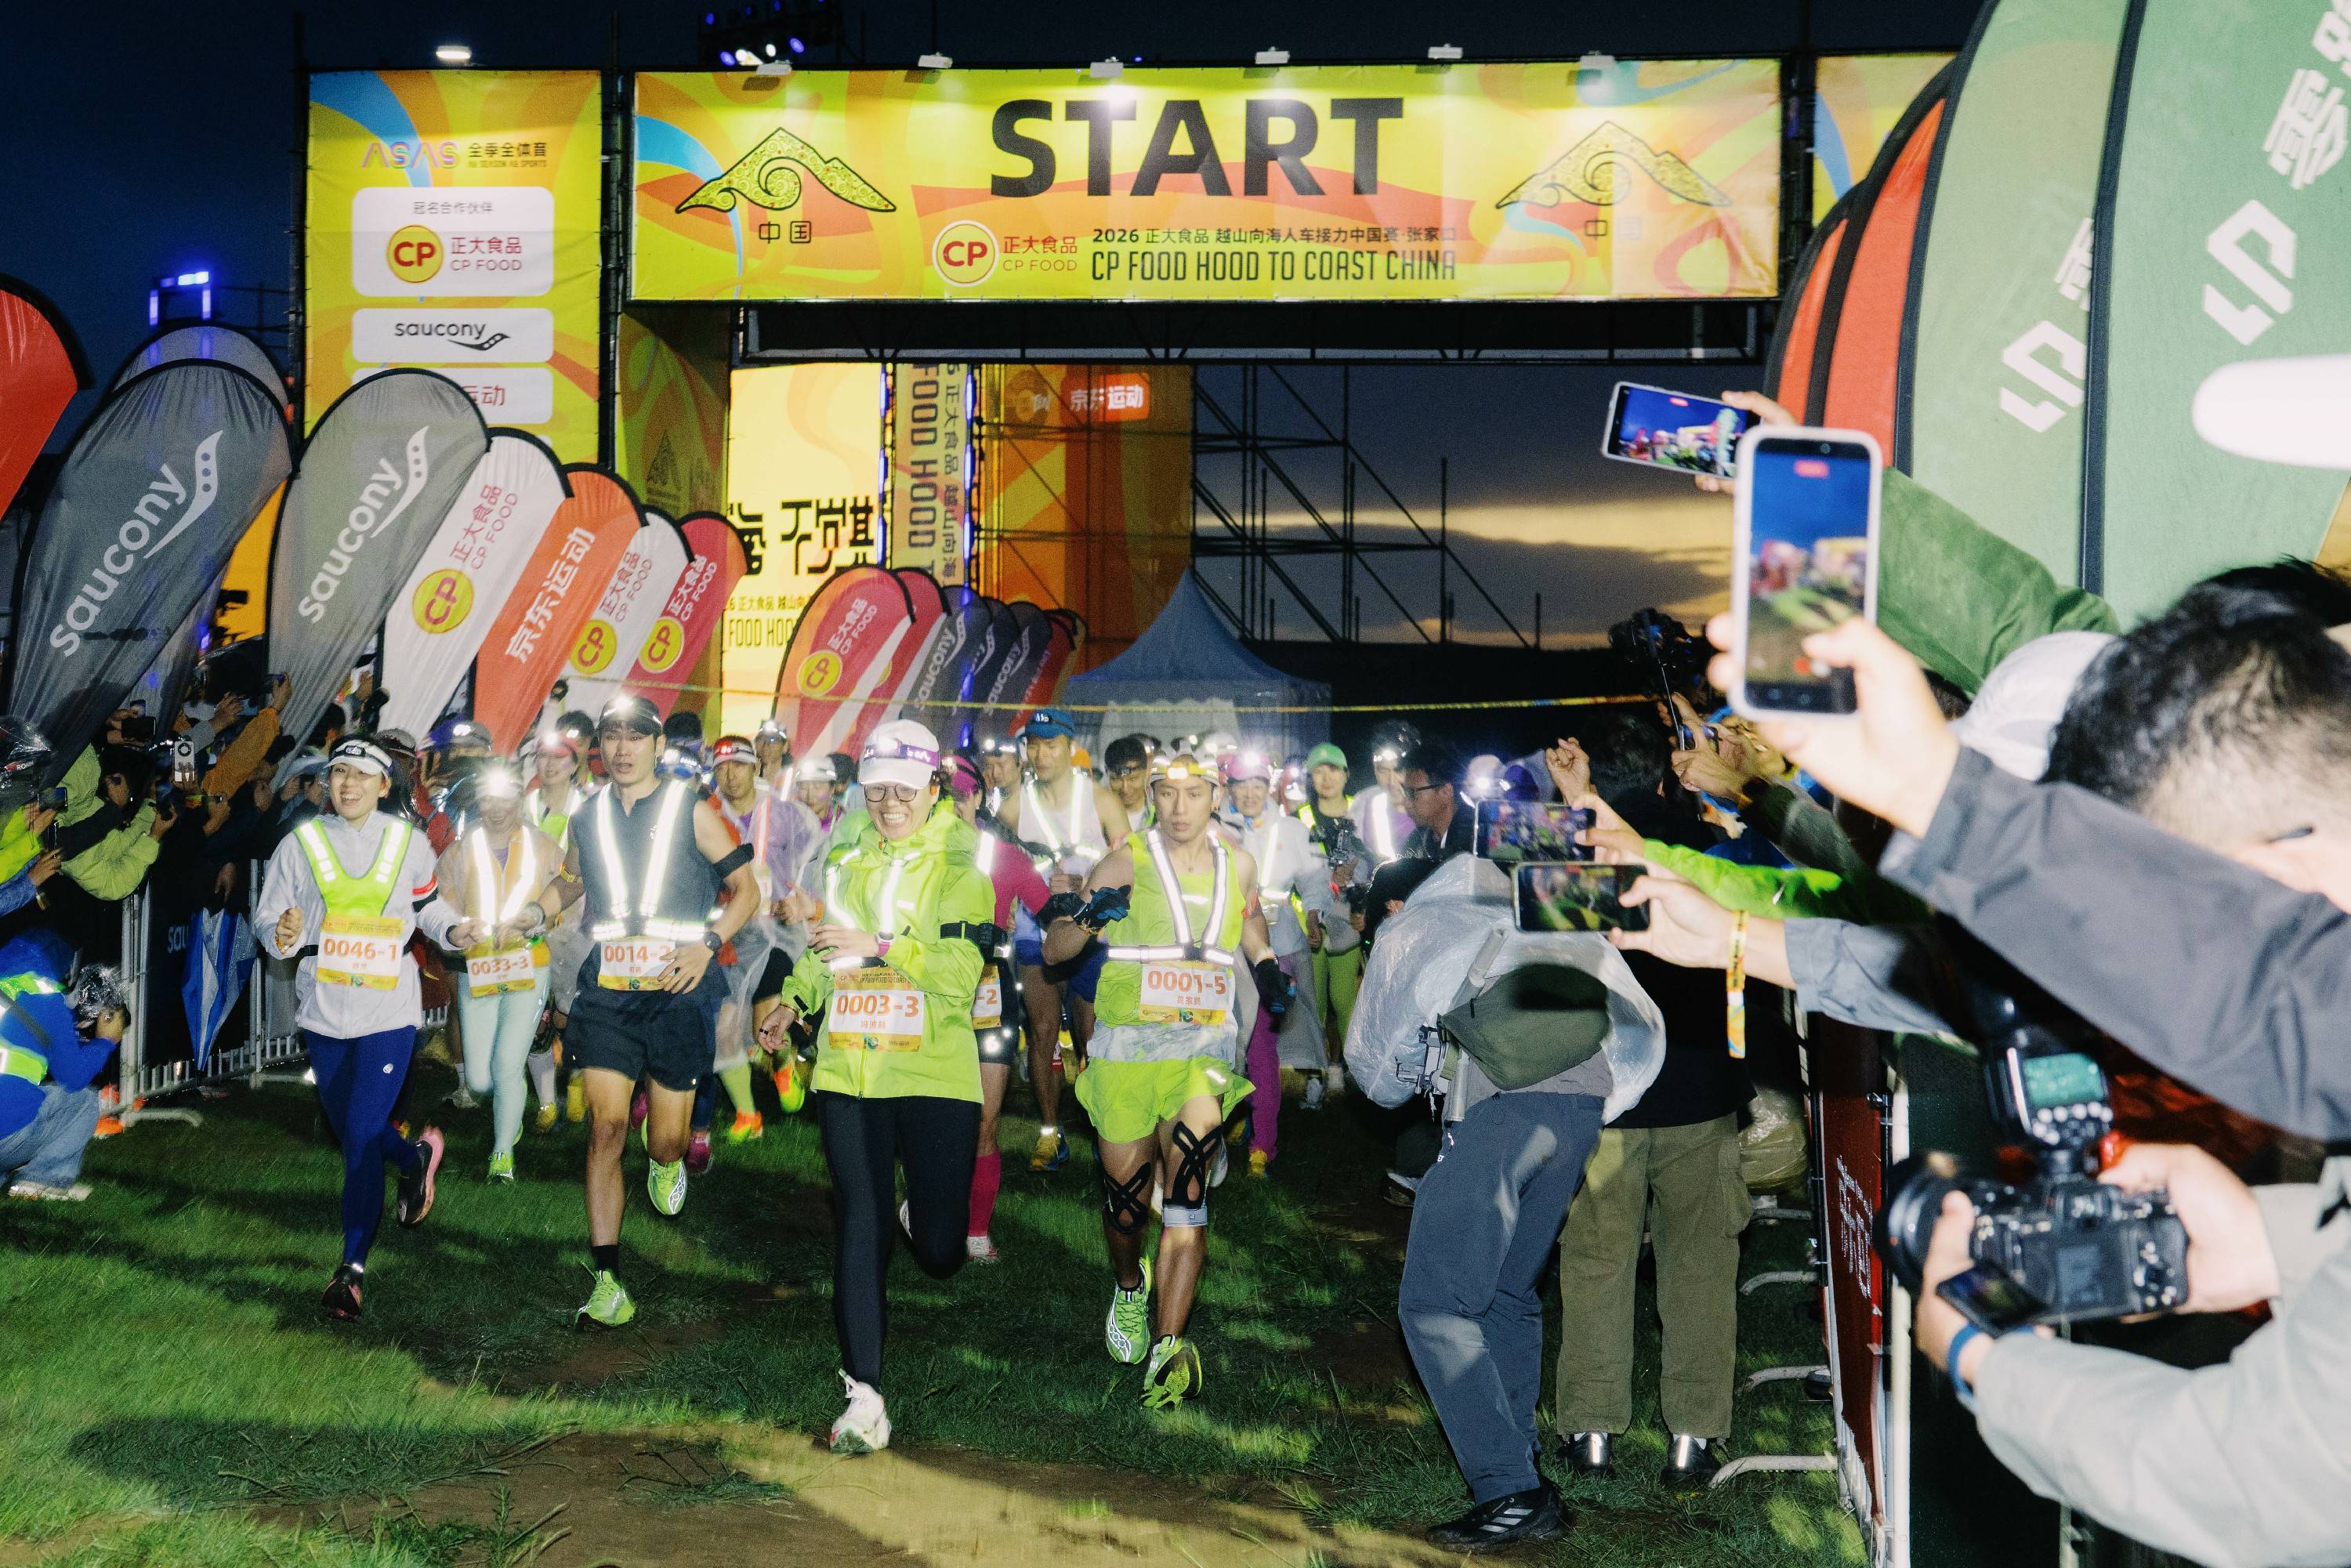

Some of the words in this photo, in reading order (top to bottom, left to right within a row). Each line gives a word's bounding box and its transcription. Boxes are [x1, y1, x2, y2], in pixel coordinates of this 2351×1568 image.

[469, 143, 547, 158] 全季全体育
[991, 97, 1404, 197] START
[451, 237, 522, 254] 正大食品
[759, 220, 812, 244] 中国
[1003, 235, 1078, 254] 正大食品
[1092, 228, 1139, 243] 2026
[1146, 228, 1209, 244] 正大食品
[1215, 227, 1399, 244] 越山向海人车接力中国赛
[1407, 227, 1456, 243] 张家口
[393, 241, 437, 267] CP
[451, 259, 470, 271] CP
[476, 259, 522, 271] FOOD
[943, 241, 988, 267] CP
[1002, 259, 1023, 271] CP
[1030, 259, 1078, 271] FOOD
[1092, 251, 1119, 281] CP
[1128, 251, 1187, 281] FOOD
[1196, 251, 1259, 281] HOOD
[1268, 251, 1295, 281] TO
[1304, 251, 1378, 281] COAST
[1386, 250, 1456, 281] CHINA
[395, 323, 487, 340] saucony
[907, 459, 938, 549] HOOD
[450, 483, 502, 563] 正大食品
[470, 546, 487, 570] CP
[485, 493, 518, 543] FOOD
[298, 458, 404, 624] saucony
[50, 464, 187, 657] saucony
[505, 527, 596, 664] 京东运动
[600, 551, 640, 616] 正大食品
[615, 603, 628, 622] CP
[627, 559, 653, 601] FOOD
[668, 554, 707, 616] 正大食品
[680, 602, 694, 621] CP
[691, 562, 718, 602] FOOD
[424, 576, 458, 626] CP
[578, 627, 604, 667] CP
[648, 625, 671, 663] CP
[729, 618, 762, 647] FOOD
[806, 657, 830, 690] CP
[323, 937, 397, 961] 0046-1
[470, 956, 528, 976] 0033-3
[1147, 970, 1226, 995] 0001-5
[836, 994, 919, 1018] 0003-3
